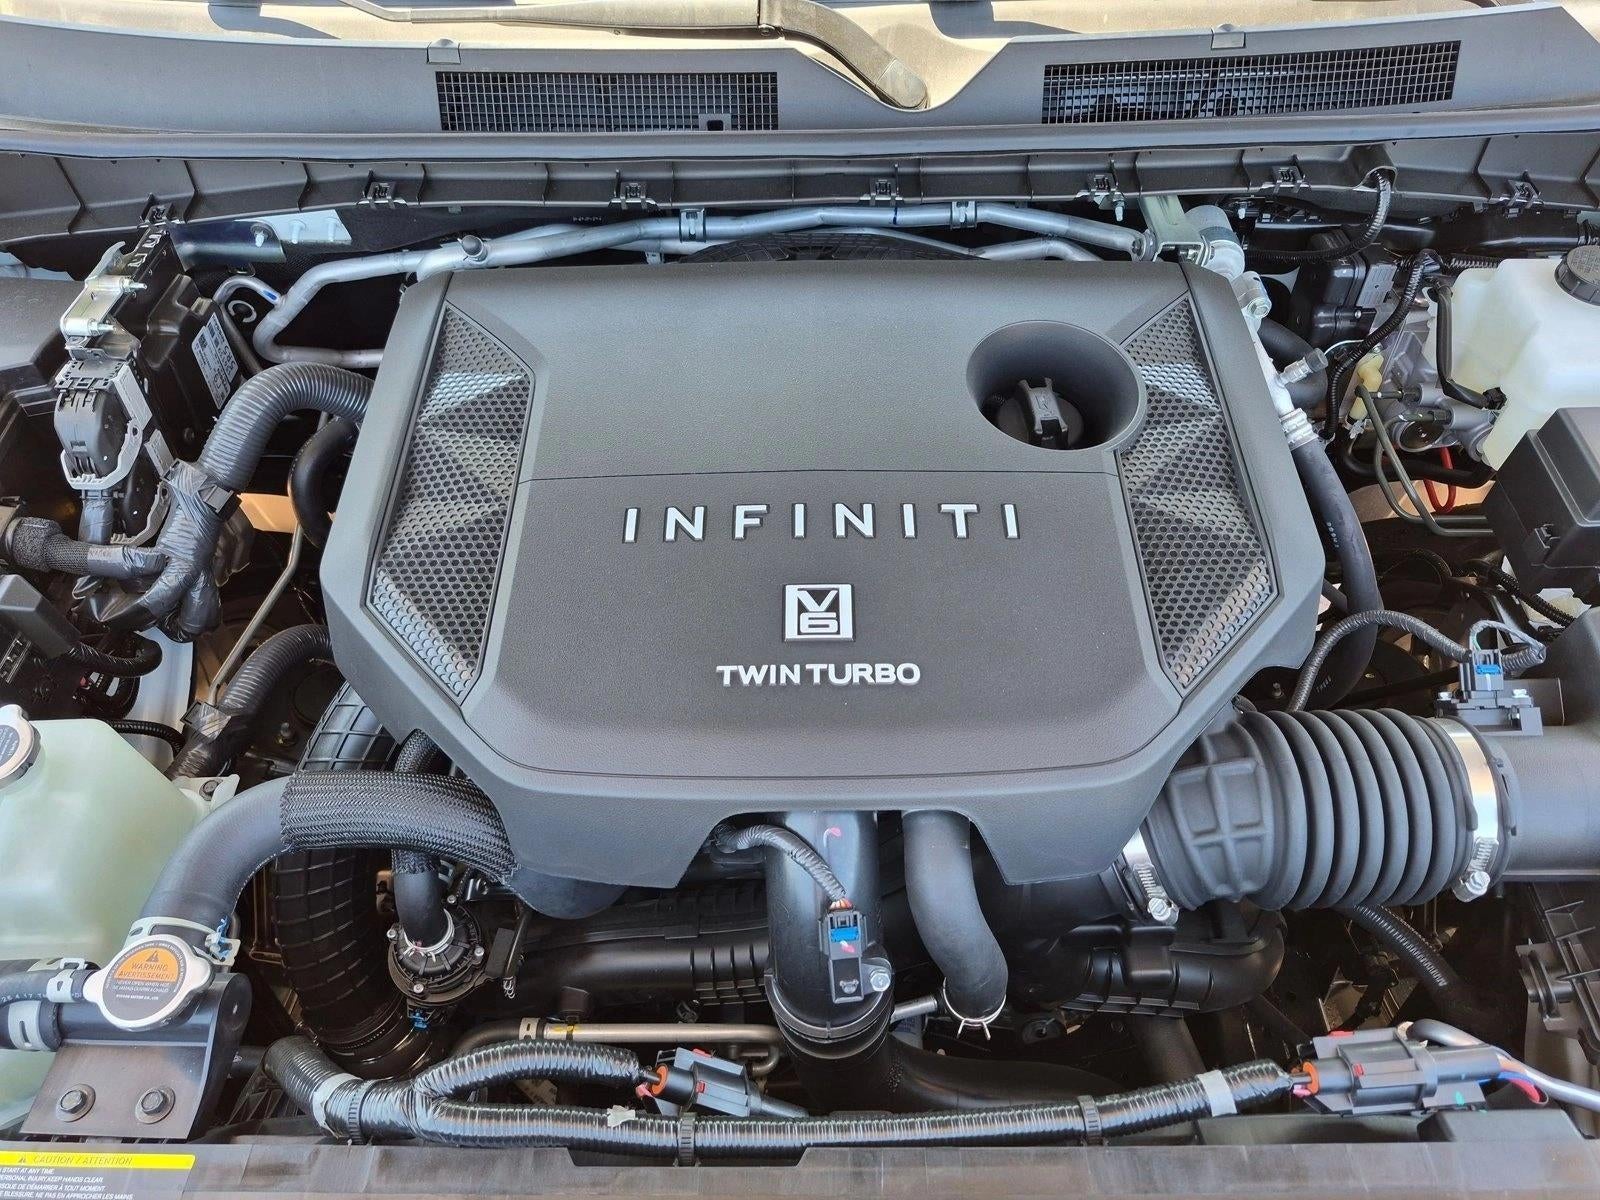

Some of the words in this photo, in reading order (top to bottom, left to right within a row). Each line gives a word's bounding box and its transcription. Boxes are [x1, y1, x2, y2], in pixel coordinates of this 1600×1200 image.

[623, 503, 1020, 542] INFINITI
[716, 664, 800, 687] TWIN
[805, 663, 921, 686] TURBO
[131, 962, 169, 971] WARNING
[119, 970, 176, 980] AVERTISSEMENT
[32, 1155, 73, 1164] CAUTION
[82, 1156, 133, 1165] ATTENTION
